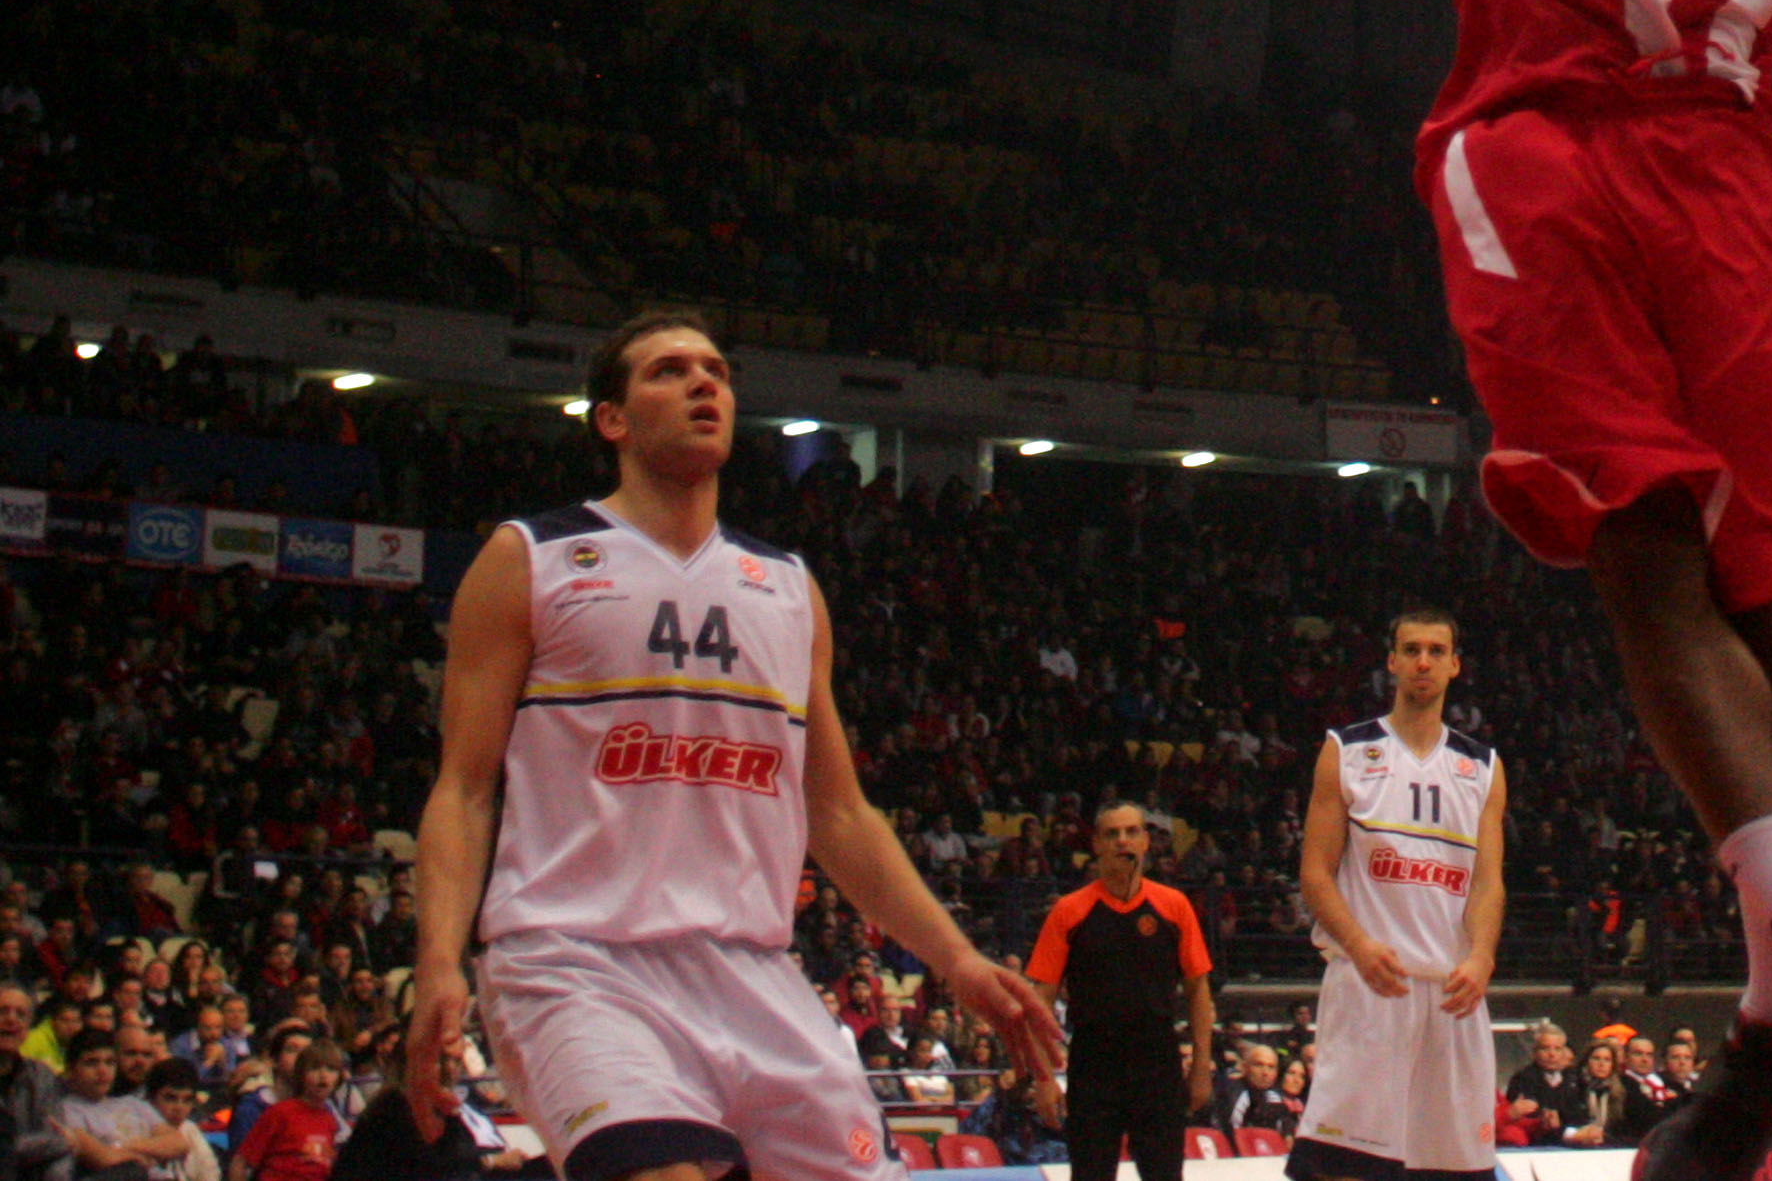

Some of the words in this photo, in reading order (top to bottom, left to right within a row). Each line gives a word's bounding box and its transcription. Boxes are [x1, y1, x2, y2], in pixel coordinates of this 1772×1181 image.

[648, 600, 739, 673] 44
[597, 722, 783, 797] ÜLKER
[1408, 782, 1441, 823] 11
[1370, 848, 1469, 897] ÜLKER
